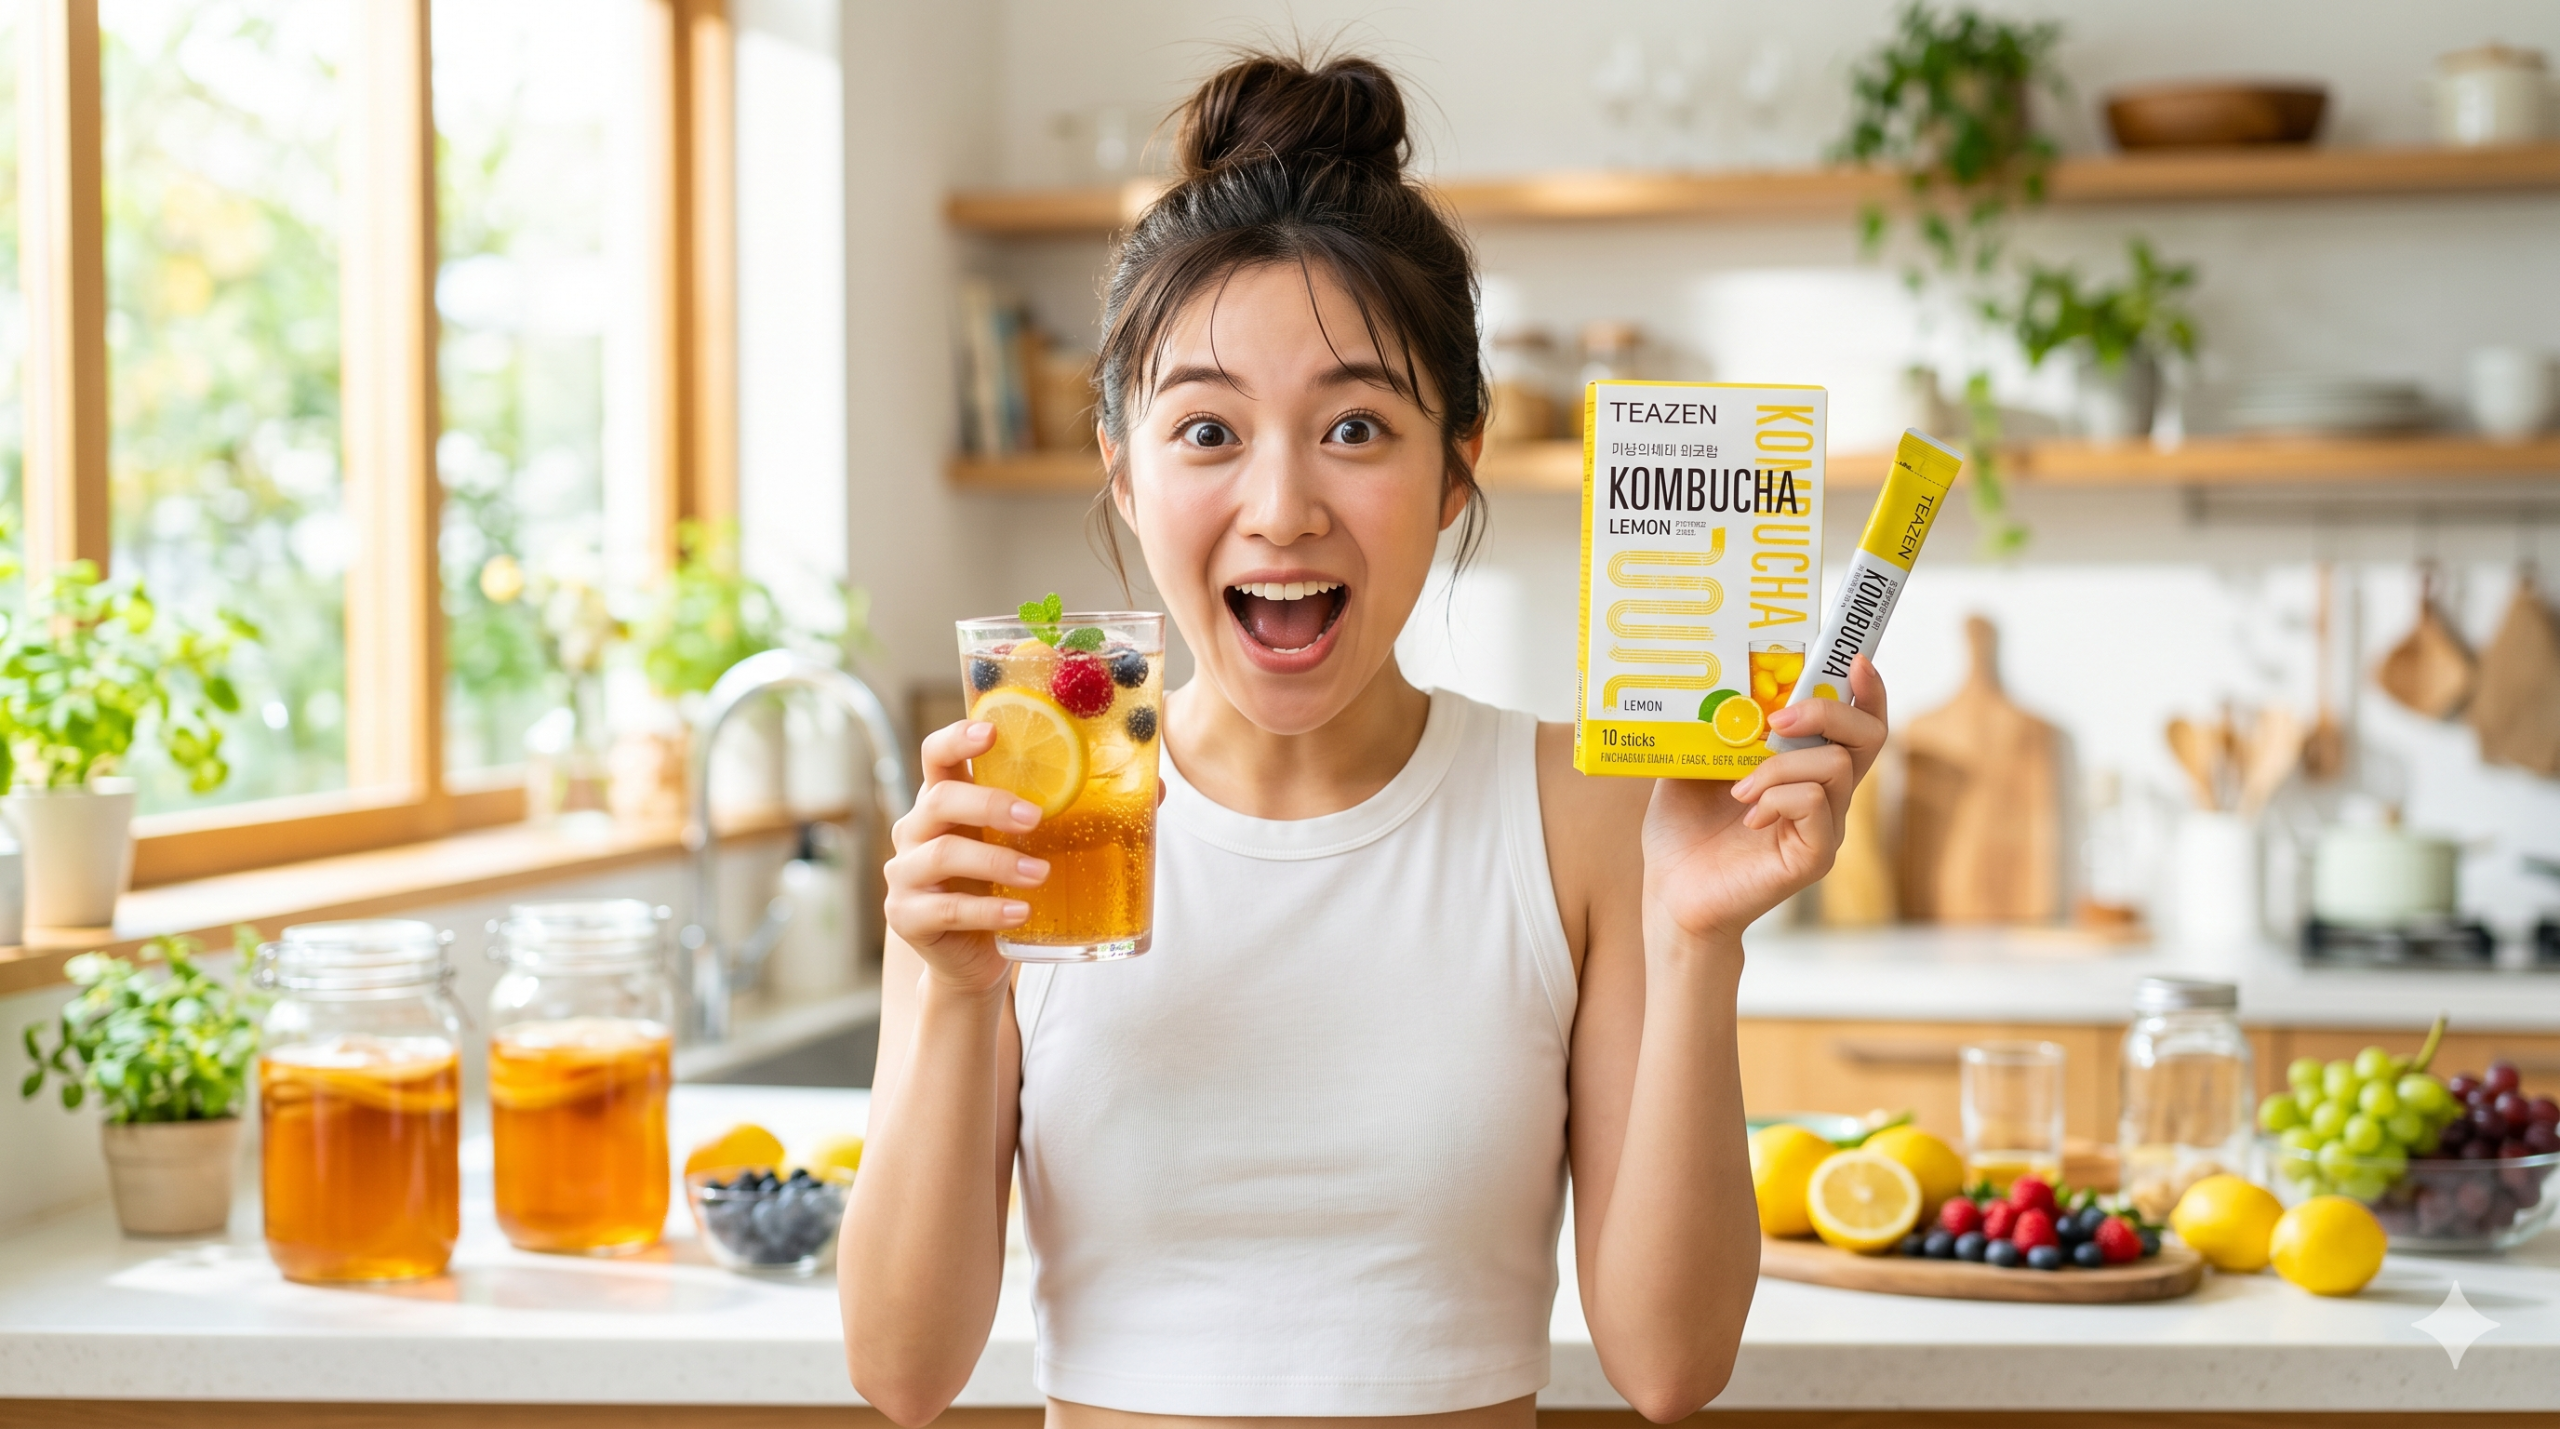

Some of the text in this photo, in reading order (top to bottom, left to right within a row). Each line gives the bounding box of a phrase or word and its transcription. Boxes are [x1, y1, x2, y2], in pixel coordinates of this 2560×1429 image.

[1609, 402, 1717, 425] TEAZEN
[1609, 466, 1798, 514] KOMBUCHA
[1609, 518, 1671, 536] LEMON
[1898, 495, 1935, 560] TEAZEN
[1821, 568, 1889, 679] KOMBUCHA
[1624, 699, 1663, 712] LEMON
[1601, 728, 1656, 747] 10 sticks
